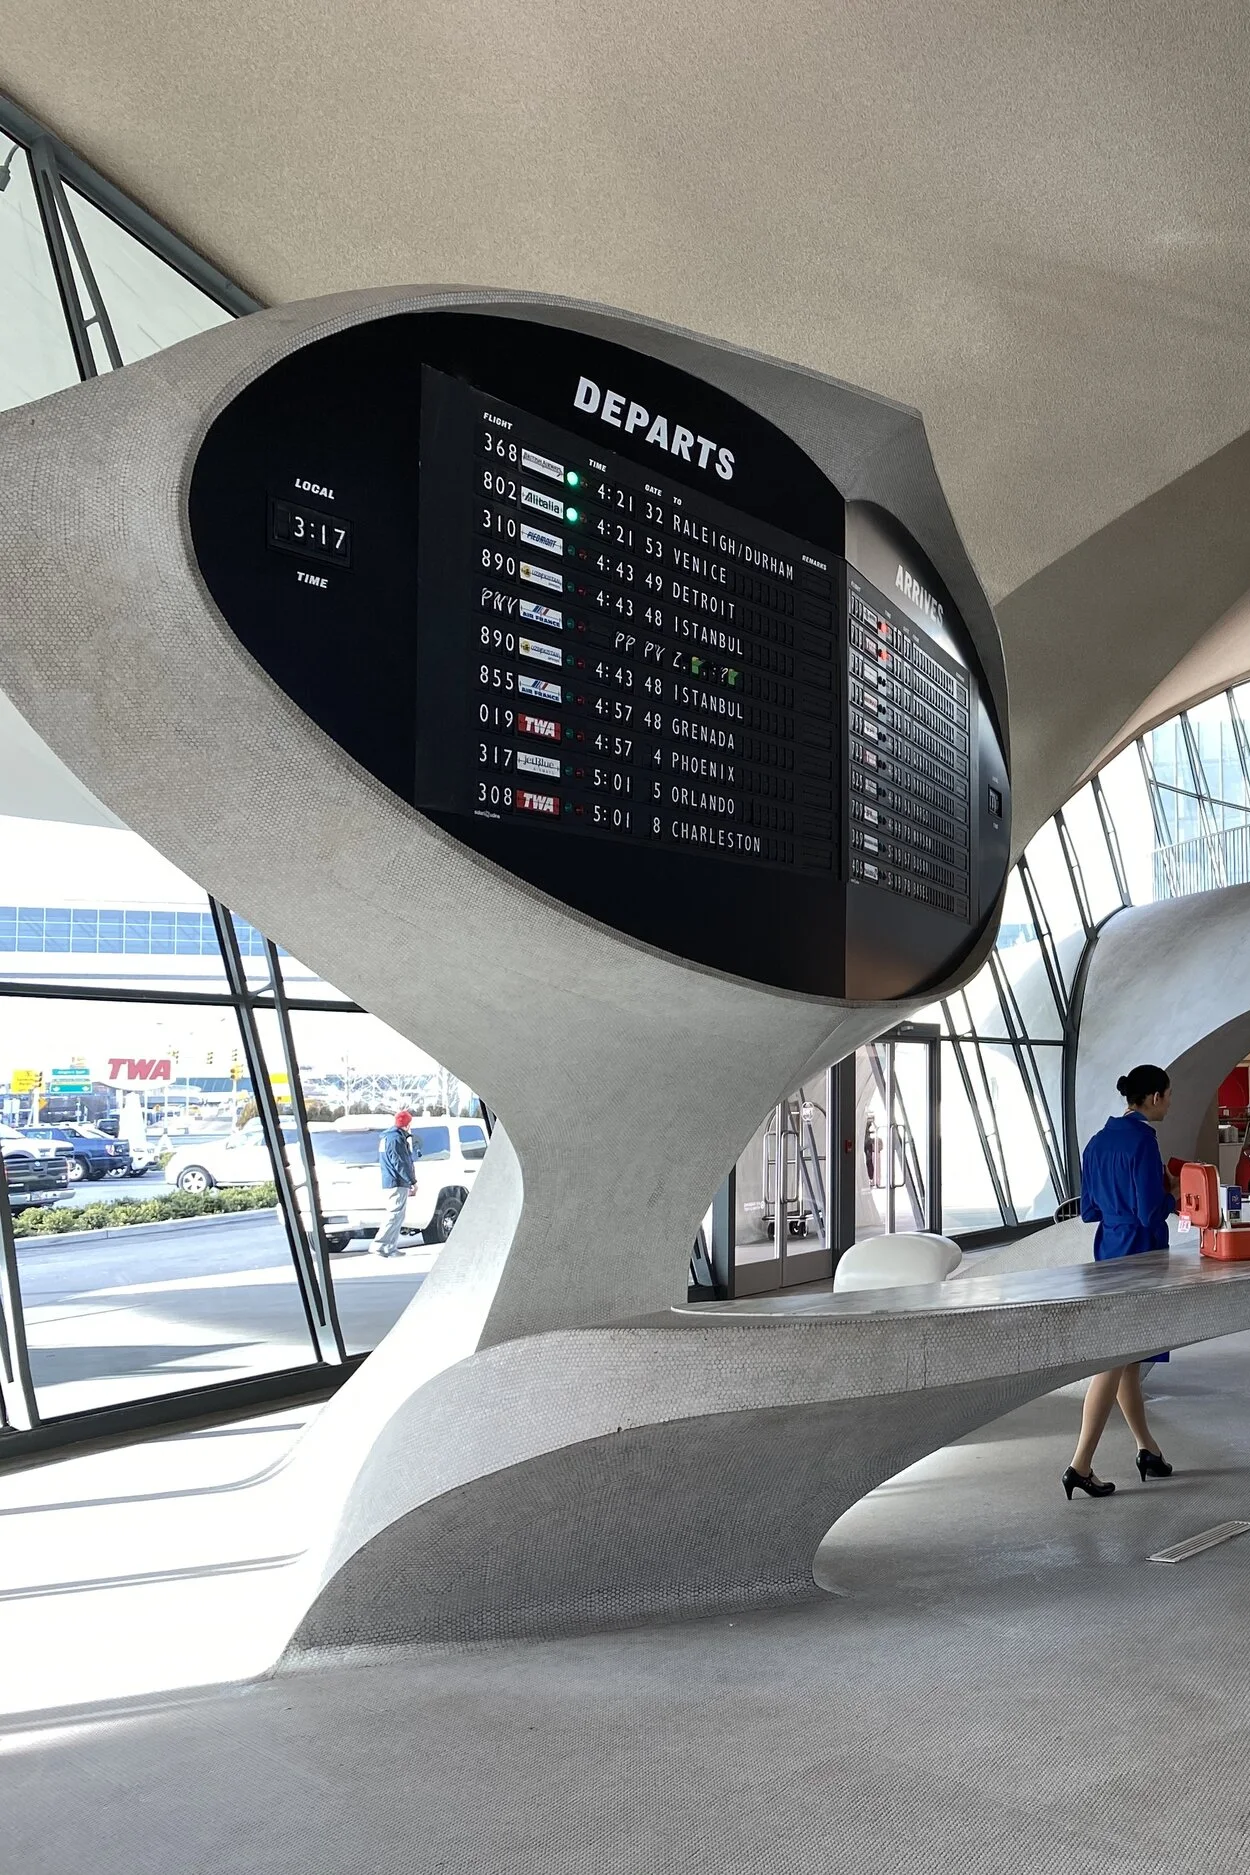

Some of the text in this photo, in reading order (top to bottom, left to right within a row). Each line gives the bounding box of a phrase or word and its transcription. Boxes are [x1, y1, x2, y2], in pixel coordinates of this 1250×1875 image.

[483, 411, 513, 430] FLIGHT
[573, 375, 735, 481] DEPARTS
[484, 432, 517, 462] 368
[588, 458, 607, 472] TIME
[294, 478, 335, 500] LOCAL
[483, 471, 517, 500] 802
[644, 484, 663, 497] GATE
[524, 491, 561, 514] Alitalia
[673, 496, 682, 506] TO
[294, 516, 346, 549] 3:17
[482, 509, 516, 537] 310
[597, 483, 794, 581] 4:21 32 RALEIGH/DURHAM
[481, 548, 516, 576] 890
[597, 518, 727, 584] 4:21 53 VENICE
[802, 554, 828, 571] REMARKS
[296, 571, 329, 589] TIME
[596, 554, 736, 620] 4:43 49 DETROIT
[895, 564, 945, 628] ARRIVES
[522, 611, 561, 628] AIR FRANCE
[596, 590, 744, 656] 4:43 48 ISTANBUL
[480, 625, 515, 651] 890
[480, 664, 514, 690] 855
[521, 687, 560, 702] AIR FRANCE
[595, 662, 744, 719] 4:43 48 ISTANBUL
[480, 703, 514, 728] 019
[524, 716, 556, 738] TWA
[595, 698, 735, 750] 4:57 48 GRENADA
[479, 743, 513, 767] 317
[595, 733, 735, 782] 4:57 4 PHOENIX
[478, 783, 513, 806] 308
[523, 792, 554, 813] TWA
[593, 769, 736, 815] 5:01 5 ORLANDO
[593, 805, 761, 853] 5:01 8 CHARLESTON
[108, 1058, 171, 1080] TWA
